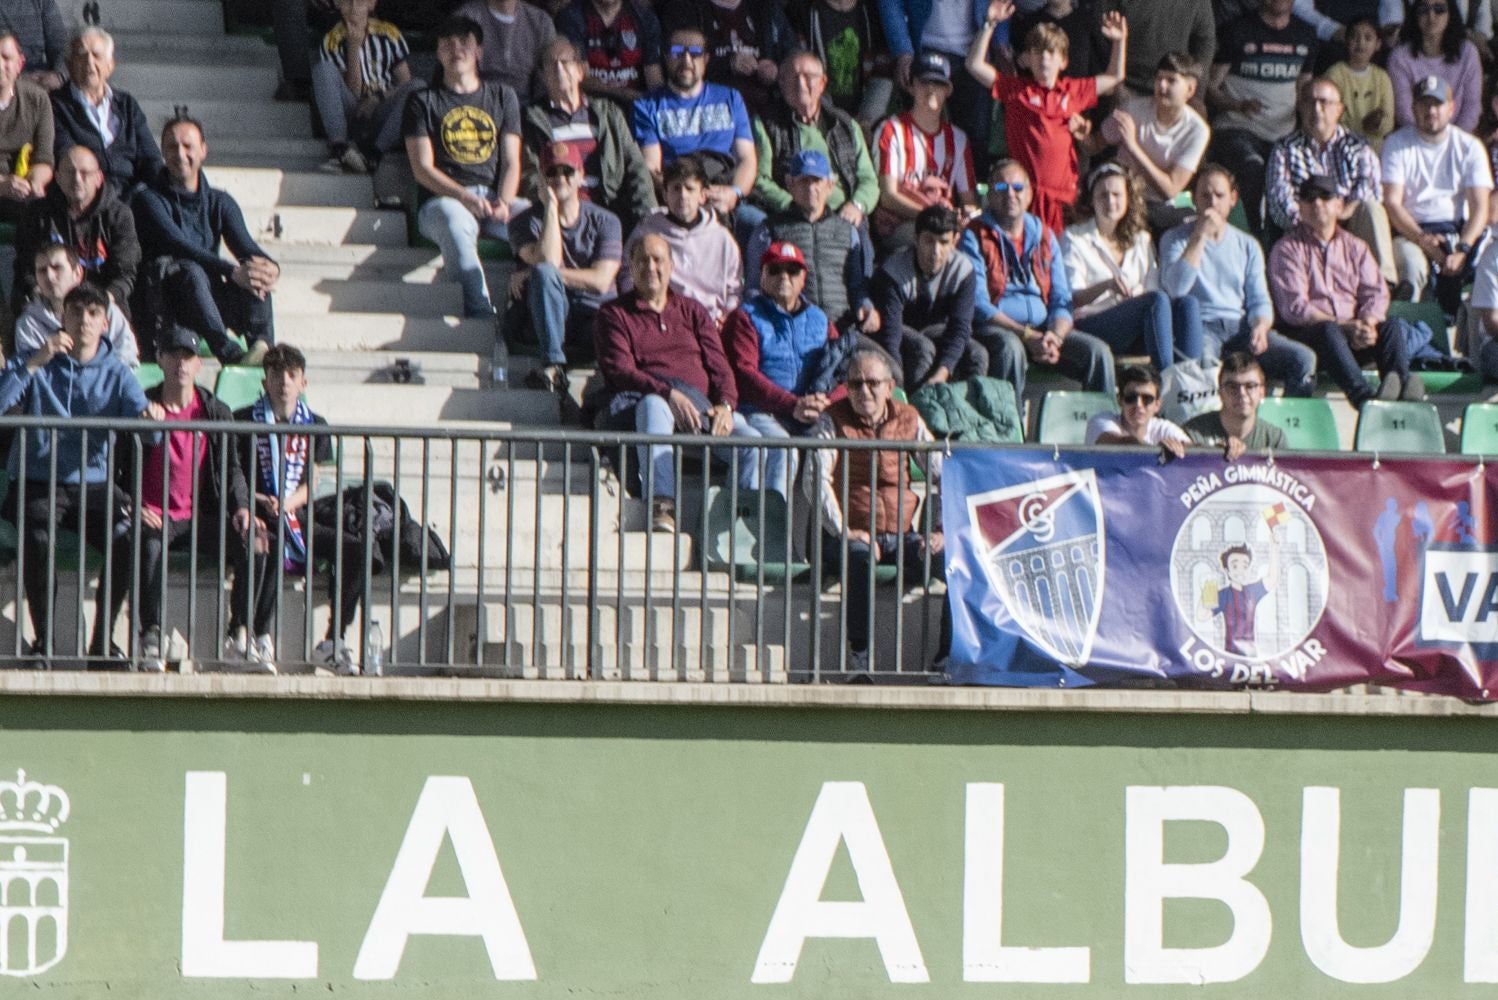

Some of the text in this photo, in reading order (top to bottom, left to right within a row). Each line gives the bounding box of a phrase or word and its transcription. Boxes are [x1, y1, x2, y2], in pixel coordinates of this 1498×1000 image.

[1285, 417, 1300, 429] 12
[1180, 464, 1316, 512] PEÑA GIMNÁSTICA
[1179, 636, 1328, 685] LOS DEL VAR
[182, 771, 537, 980] LA
